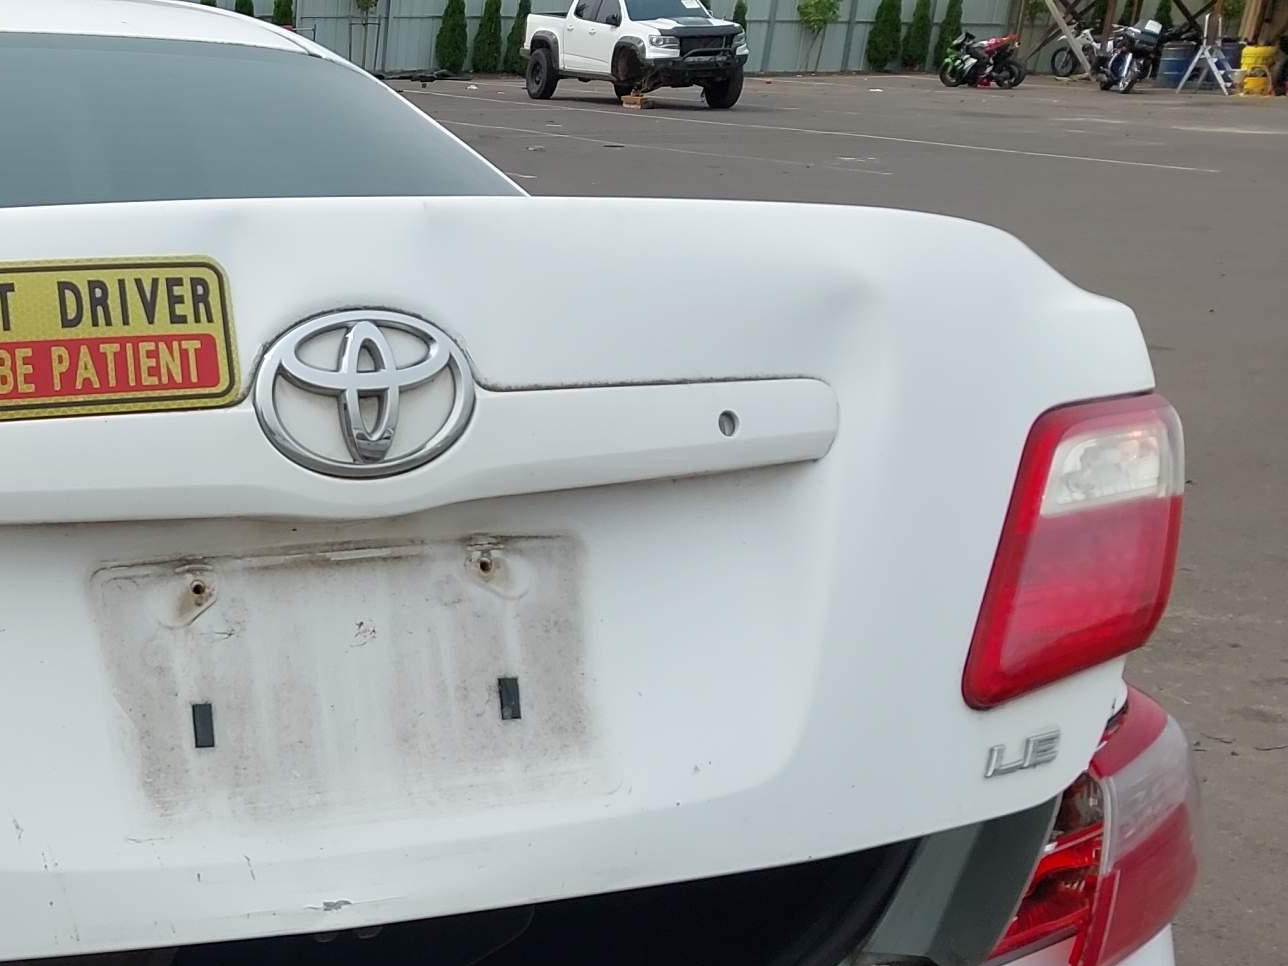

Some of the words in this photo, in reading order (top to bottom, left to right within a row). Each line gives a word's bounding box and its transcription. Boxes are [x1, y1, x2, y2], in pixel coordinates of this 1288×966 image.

[57, 277, 214, 328] DRIVER
[52, 340, 201, 391] PATIENT
[983, 729, 1060, 778] LE
